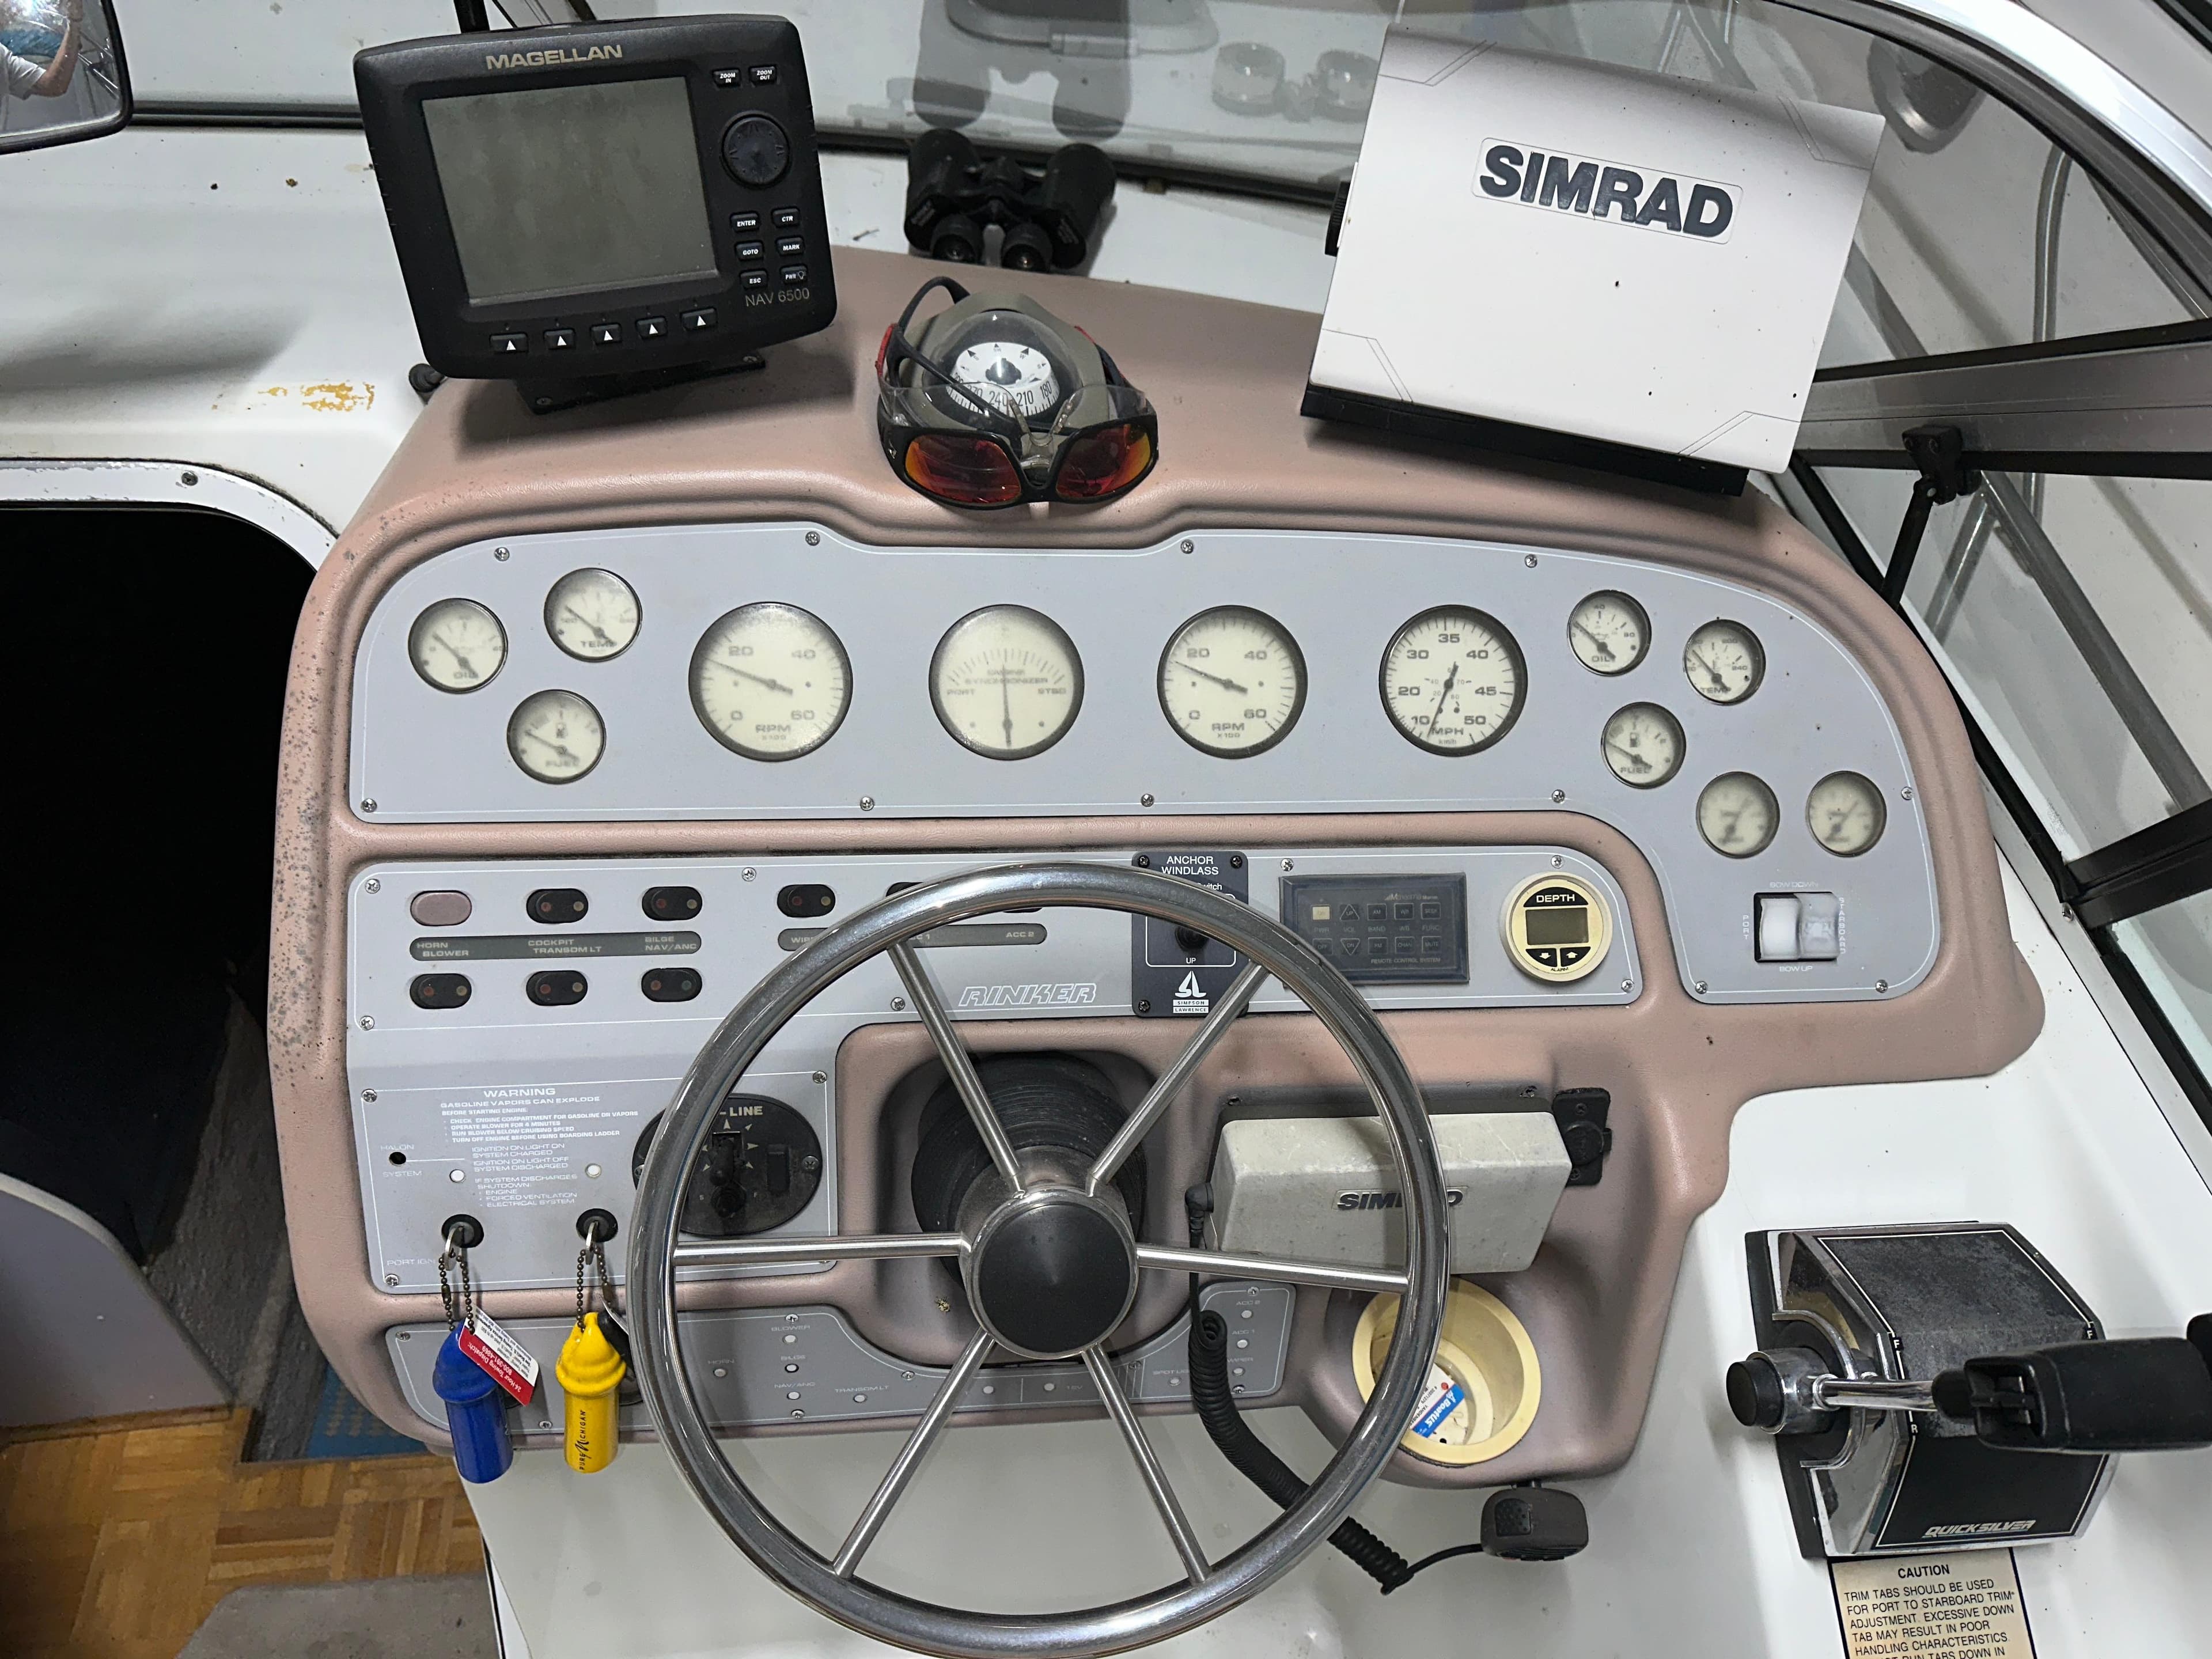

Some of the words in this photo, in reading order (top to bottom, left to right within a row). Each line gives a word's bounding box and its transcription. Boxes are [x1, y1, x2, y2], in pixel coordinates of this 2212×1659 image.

[486, 44, 623, 70] MAGELLAN
[1480, 145, 1734, 238] SIMRAD
[745, 292, 774, 307] NAV
[778, 288, 809, 303] 6500
[1040, 381, 1052, 399] 180
[989, 390, 1007, 406] 240
[1016, 389, 1034, 407] 210
[1438, 633, 1460, 643] 35
[728, 646, 753, 656] 20
[791, 649, 816, 659] 40
[1187, 647, 1210, 658] 20
[1244, 650, 1267, 660] 40
[1407, 650, 1429, 660] 30
[1466, 650, 1488, 660] 40
[1398, 686, 1421, 696] 20
[1475, 686, 1497, 696] 45
[730, 710, 743, 721] 0
[790, 710, 815, 720] 60
[1188, 710, 1200, 720] 0
[1244, 709, 1267, 719] 60
[1411, 715, 1430, 725] 10
[1464, 715, 1486, 725] 50
[755, 724, 791, 733] RPM
[1212, 722, 1245, 732] RPM
[1430, 728, 1464, 736] MPH
[1166, 856, 1214, 865] ANCHOR
[1161, 866, 1219, 876] WINDLASS
[1536, 894, 1575, 903] DEPTH
[958, 983, 1097, 1006] RINKER
[483, 1088, 556, 1097] WARNING
[1337, 1189, 1464, 1210] SIMD
[2086, 1330, 2093, 1339] F
[1893, 1339, 1900, 1349] F
[466, 1341, 490, 1363] Dispatch:
[487, 1359, 506, 1377] Towing
[503, 1374, 522, 1392] 24-Hour
[1911, 1424, 1918, 1433] R
[1925, 1520, 2036, 1537] QUICKSILVER
[1898, 1564, 1950, 1578] CAUTION
[1844, 1590, 1870, 1601] TRIM
[1873, 1588, 1900, 1599] TABS
[1903, 1584, 1946, 1597] SHOULD
[1949, 1582, 1963, 1592] BE
[1966, 1579, 1994, 1590] USED
[1847, 1604, 1869, 1615] FOR
[1872, 1601, 1900, 1612] PORT
[1903, 1600, 1918, 1610] TO
[1922, 1593, 1984, 1608] STARBOARD
[1923, 1607, 1980, 1622] EXCESSIVE
[1983, 1604, 2014, 1616] DOWN
[1852, 1631, 1873, 1642] TAB
[1876, 1629, 1898, 1640] MAY
[1902, 1624, 1942, 1638] RESULT
[1946, 1623, 1957, 1634] IN
[1960, 1620, 1990, 1632] POOR
[1855, 1642, 1908, 1656] HANDLING
[1959, 1648, 1991, 1659] DOWN
[1994, 1646, 2005, 1656] IN
